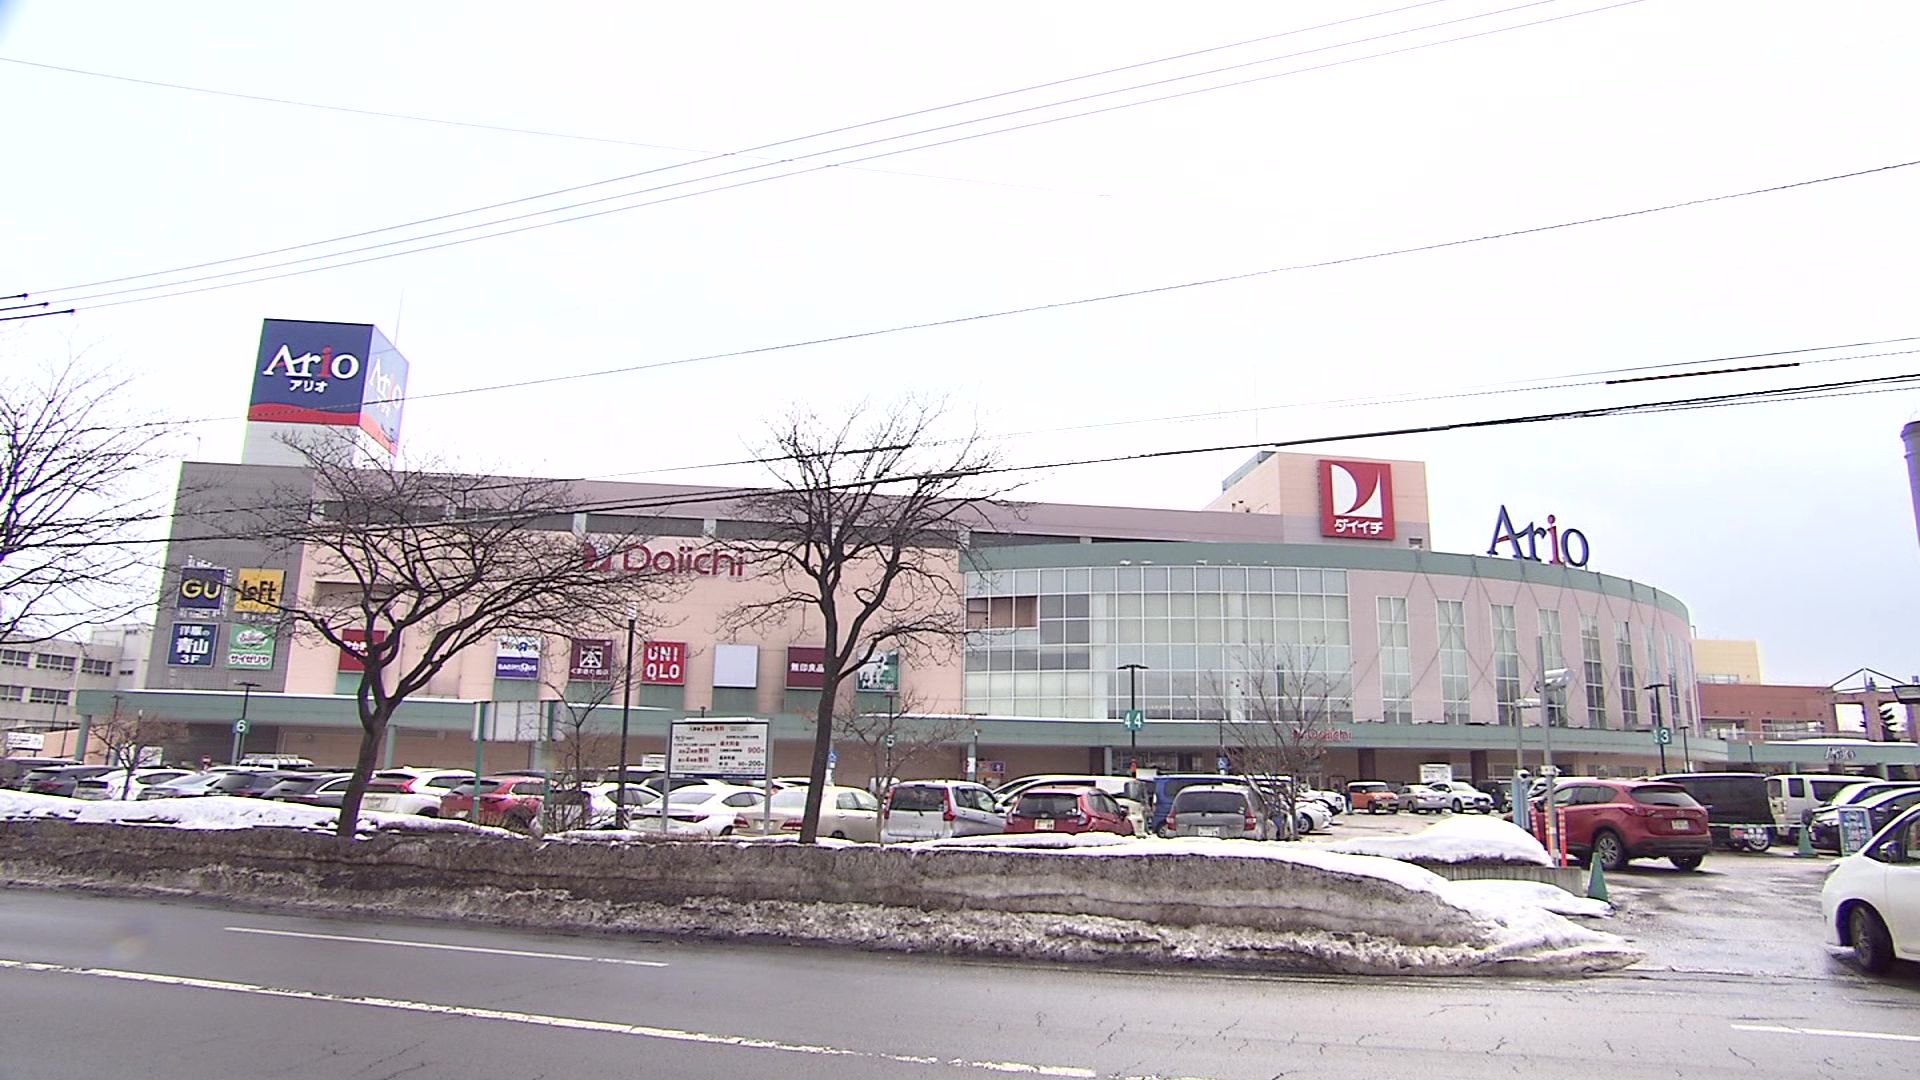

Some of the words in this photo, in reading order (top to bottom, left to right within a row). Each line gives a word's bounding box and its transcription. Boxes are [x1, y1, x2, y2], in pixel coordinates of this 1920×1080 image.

[263, 344, 360, 379] Ario
[289, 379, 329, 393] アリオ
[1334, 518, 1384, 536] ダイイチ
[1486, 504, 1590, 568] Ario
[623, 543, 745, 577] Daiichi
[181, 579, 221, 599] GU
[176, 637, 209, 654] 青山
[180, 654, 201, 664] 3F
[647, 646, 678, 662] UNI
[646, 663, 680, 681] QLO
[236, 719, 247, 732] 6
[1132, 714, 1143, 729] 4
[886, 735, 896, 747] 5
[1660, 728, 1670, 743] 3
